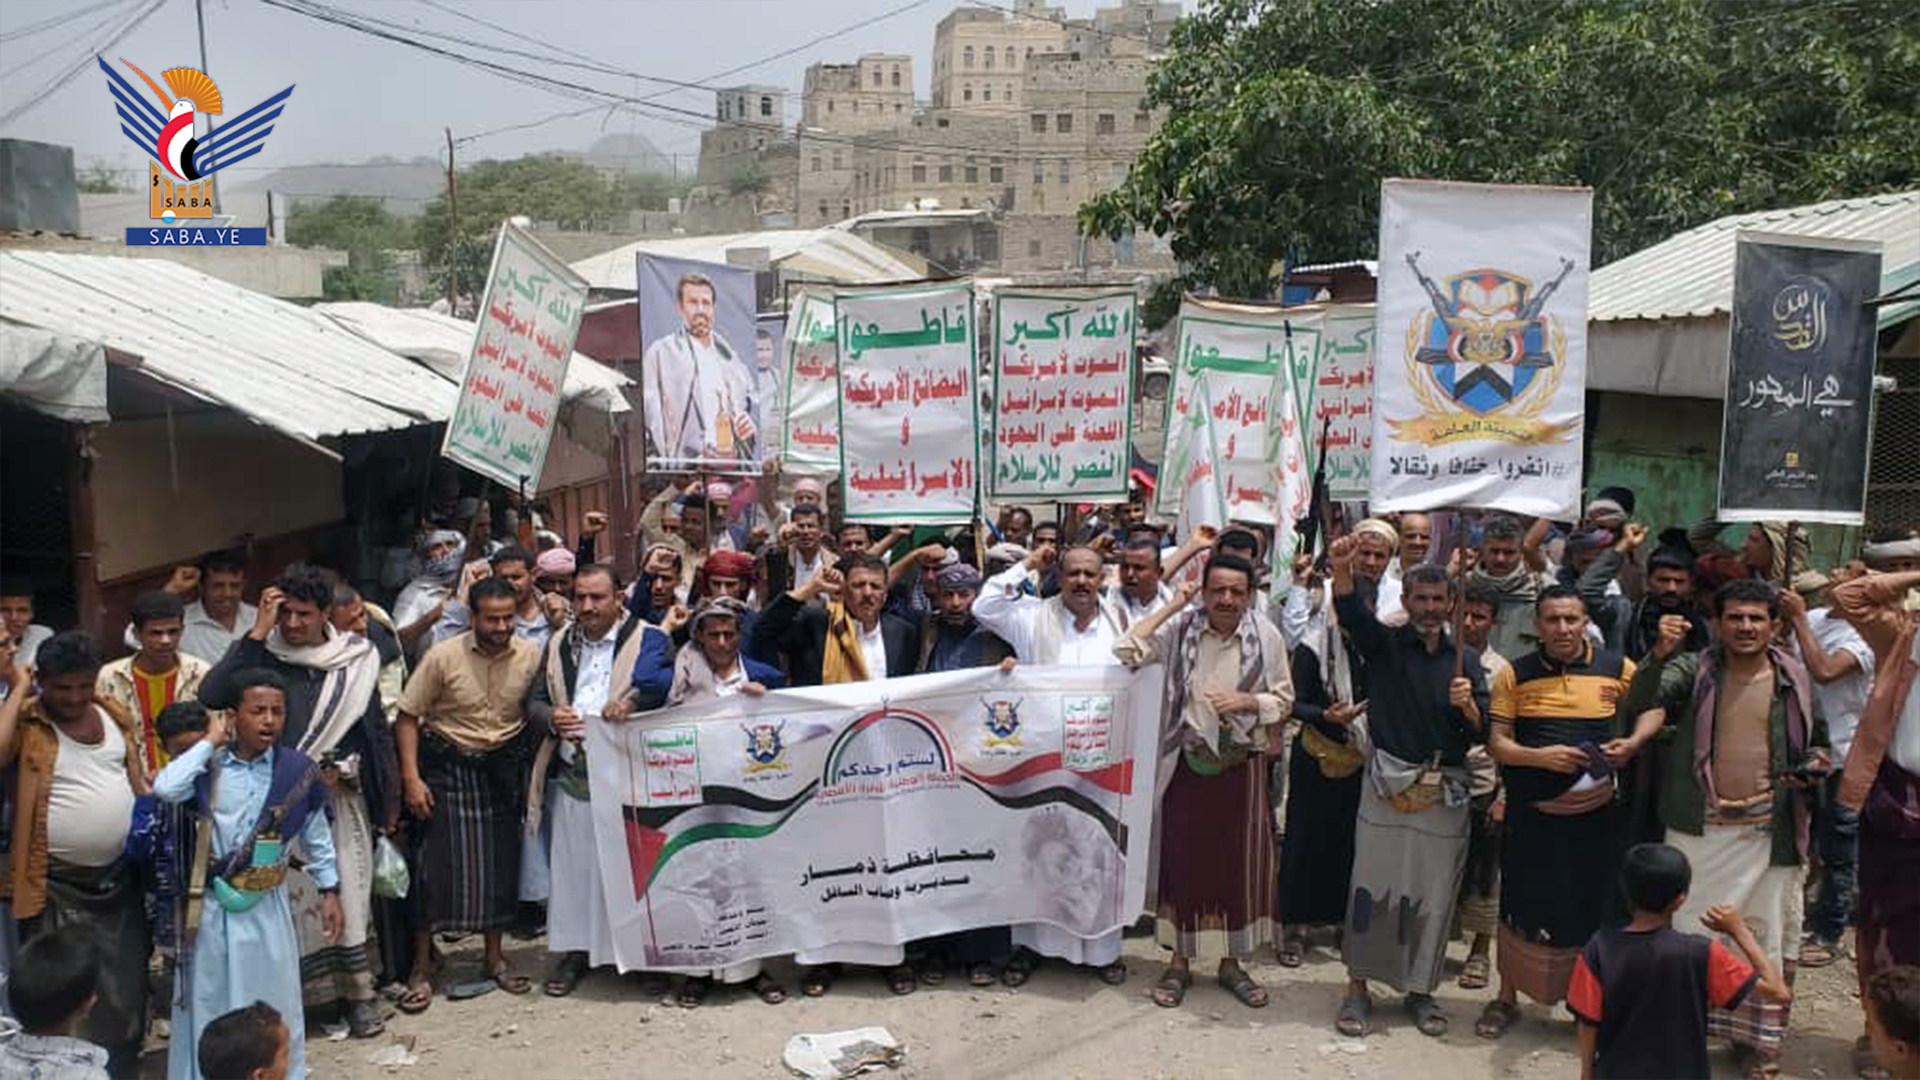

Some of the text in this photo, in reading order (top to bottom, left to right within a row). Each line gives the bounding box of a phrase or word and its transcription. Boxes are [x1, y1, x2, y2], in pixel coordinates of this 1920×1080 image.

[843, 305, 966, 360] قاطعوا
[1082, 305, 1129, 339] الله
[901, 416, 911, 446] و
[850, 458, 973, 498] الإسرائيلية
[999, 449, 1122, 490] النصر للإسلام
[799, 847, 996, 887] محافظة ذمار
[904, 874, 971, 894] مديرية
